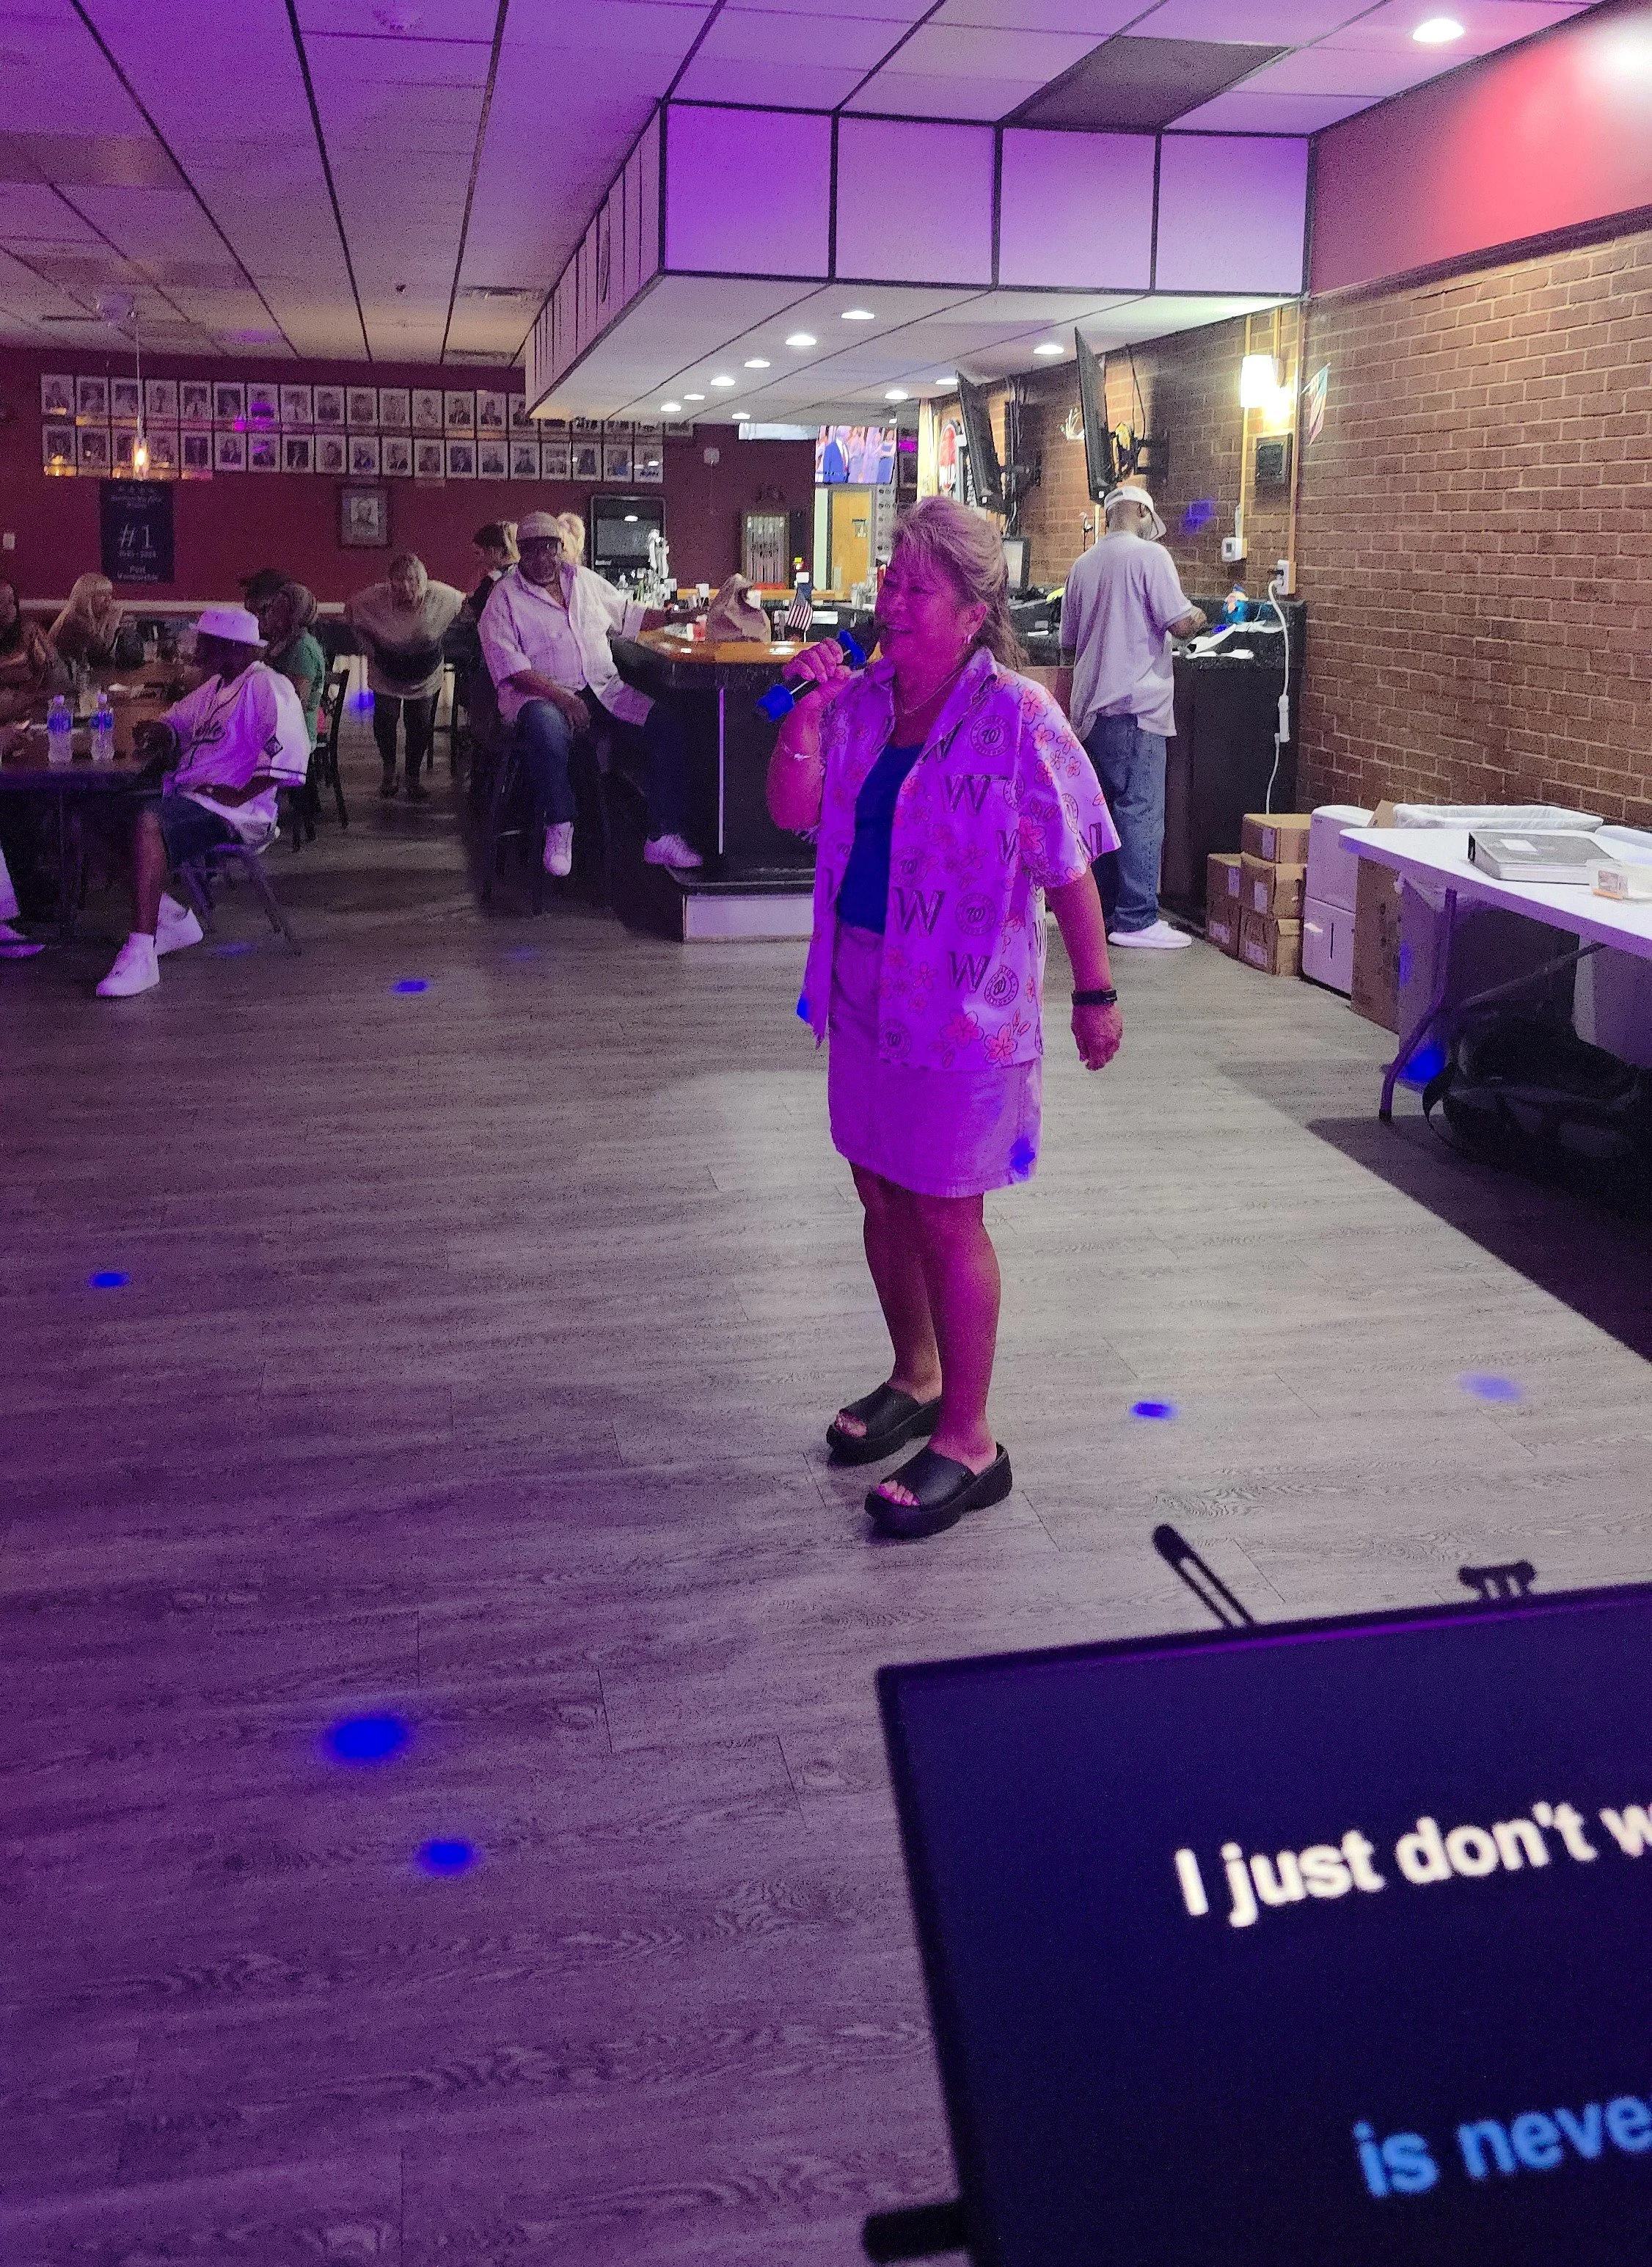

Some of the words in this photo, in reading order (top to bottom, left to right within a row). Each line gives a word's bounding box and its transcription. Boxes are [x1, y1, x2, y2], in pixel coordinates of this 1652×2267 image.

[118, 522, 153, 550] #1
[940, 774, 991, 817] W
[891, 886, 945, 937] W
[947, 951, 991, 993] W
[1175, 1847, 1209, 1916] I
[1221, 1828, 1386, 1929] just
[1395, 1800, 1598, 1885] don't
[1354, 2121, 1439, 2197] is
[1457, 2096, 1652, 2180] neve
